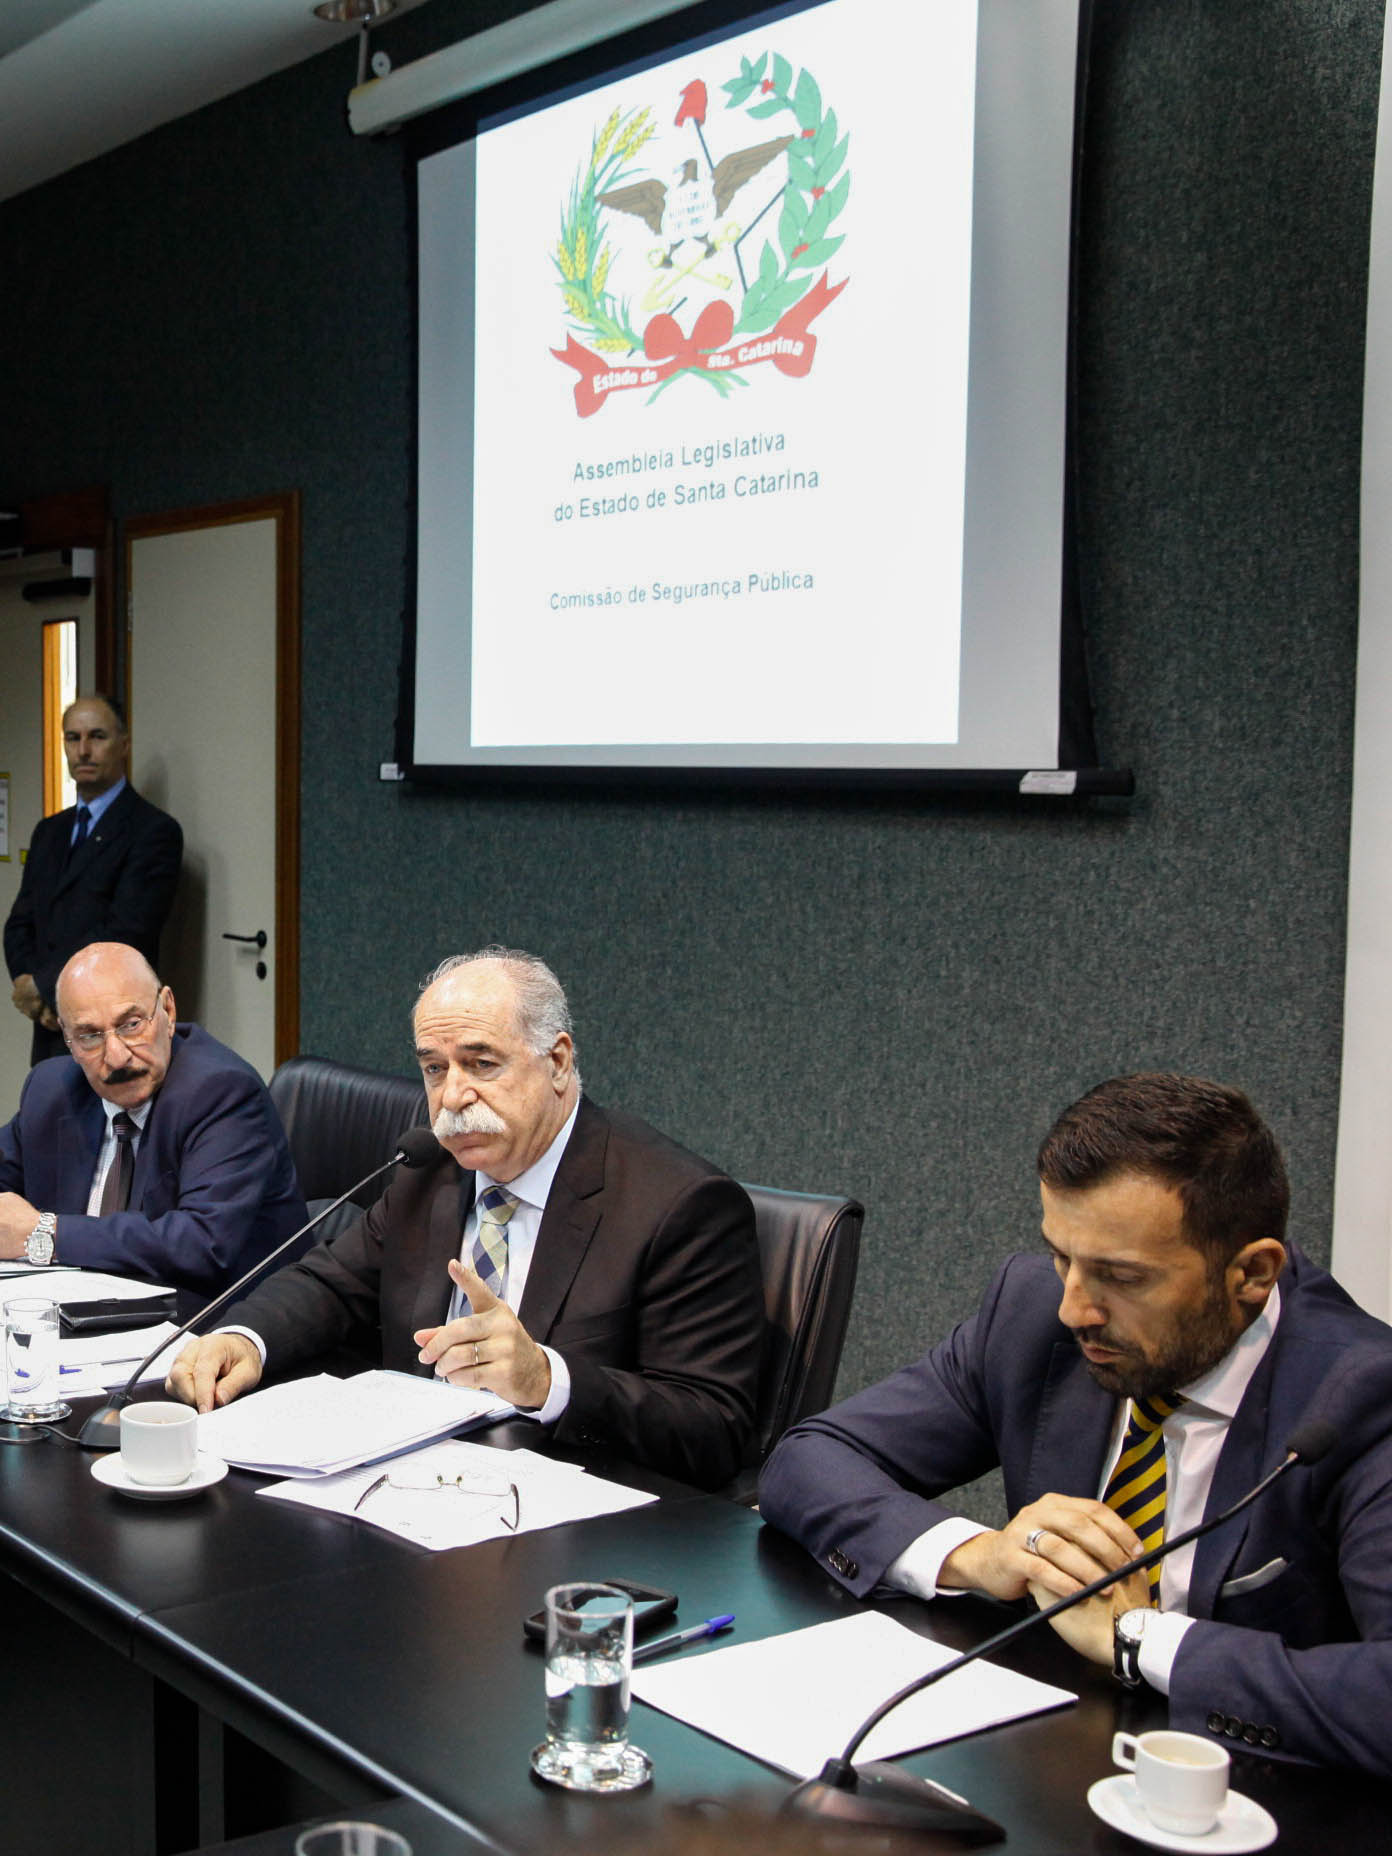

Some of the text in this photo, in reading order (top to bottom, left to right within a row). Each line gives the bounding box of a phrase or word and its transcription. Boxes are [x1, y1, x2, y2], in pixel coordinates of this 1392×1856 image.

[593, 369, 637, 394] Estado
[641, 370, 658, 383] de
[738, 337, 804, 363] Catarina
[573, 432, 785, 482] Assembleia Legislativa
[554, 469, 819, 522] do Estado de Santa Catarina
[550, 586, 622, 610] Comissão
[628, 585, 646, 603] de
[652, 574, 741, 604] Segurança
